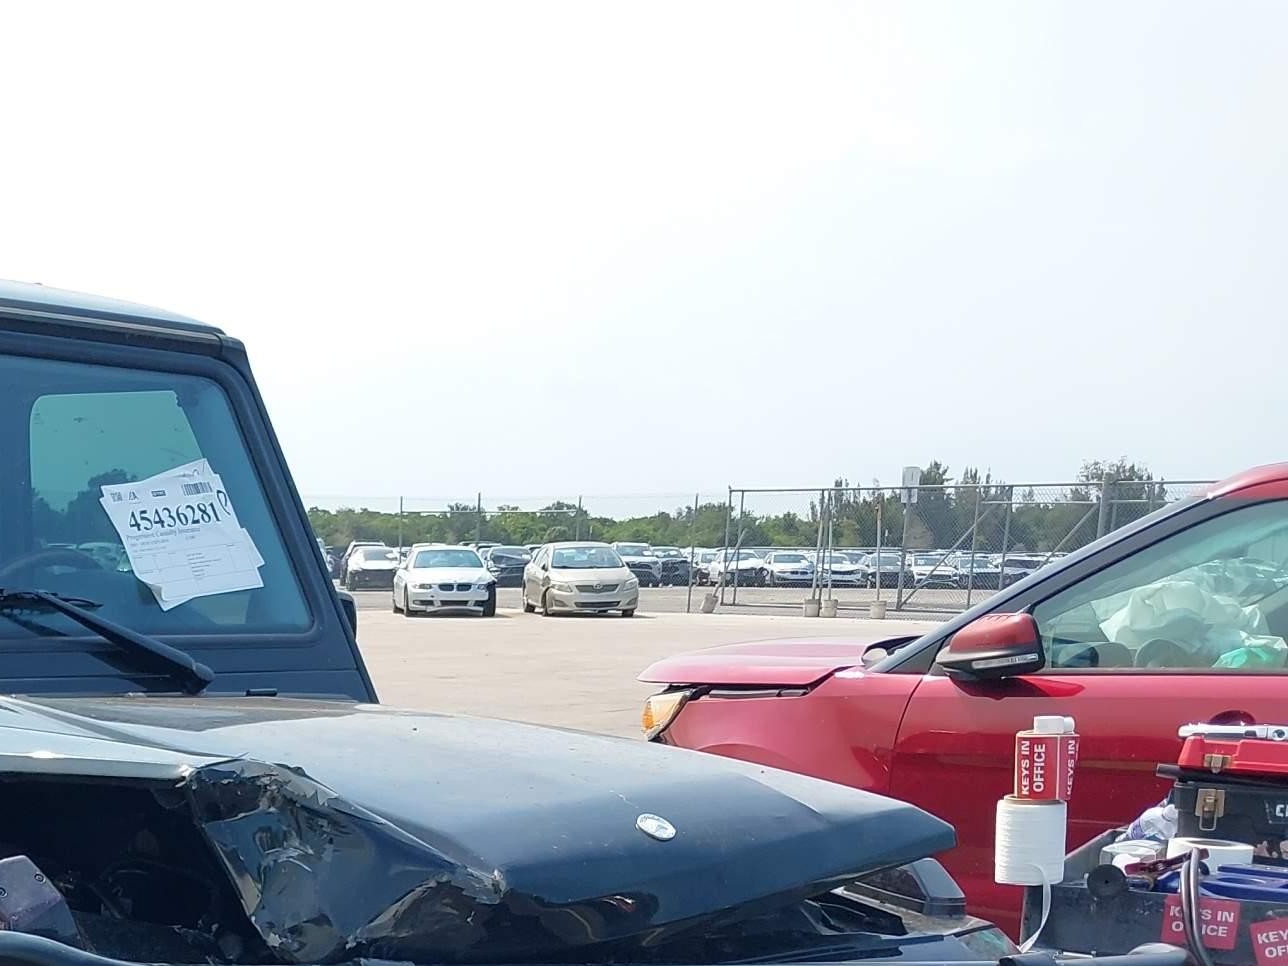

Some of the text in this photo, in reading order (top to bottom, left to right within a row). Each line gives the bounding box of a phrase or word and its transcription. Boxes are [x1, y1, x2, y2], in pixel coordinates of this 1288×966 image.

[129, 502, 221, 531] 45436281
[1021, 740, 1030, 795] KEYS IN
[1033, 744, 1046, 792] OFFICE
[1067, 740, 1075, 795] KEYS IN
[1169, 905, 1234, 922] KS IN
[1172, 921, 1228, 937] OICE
